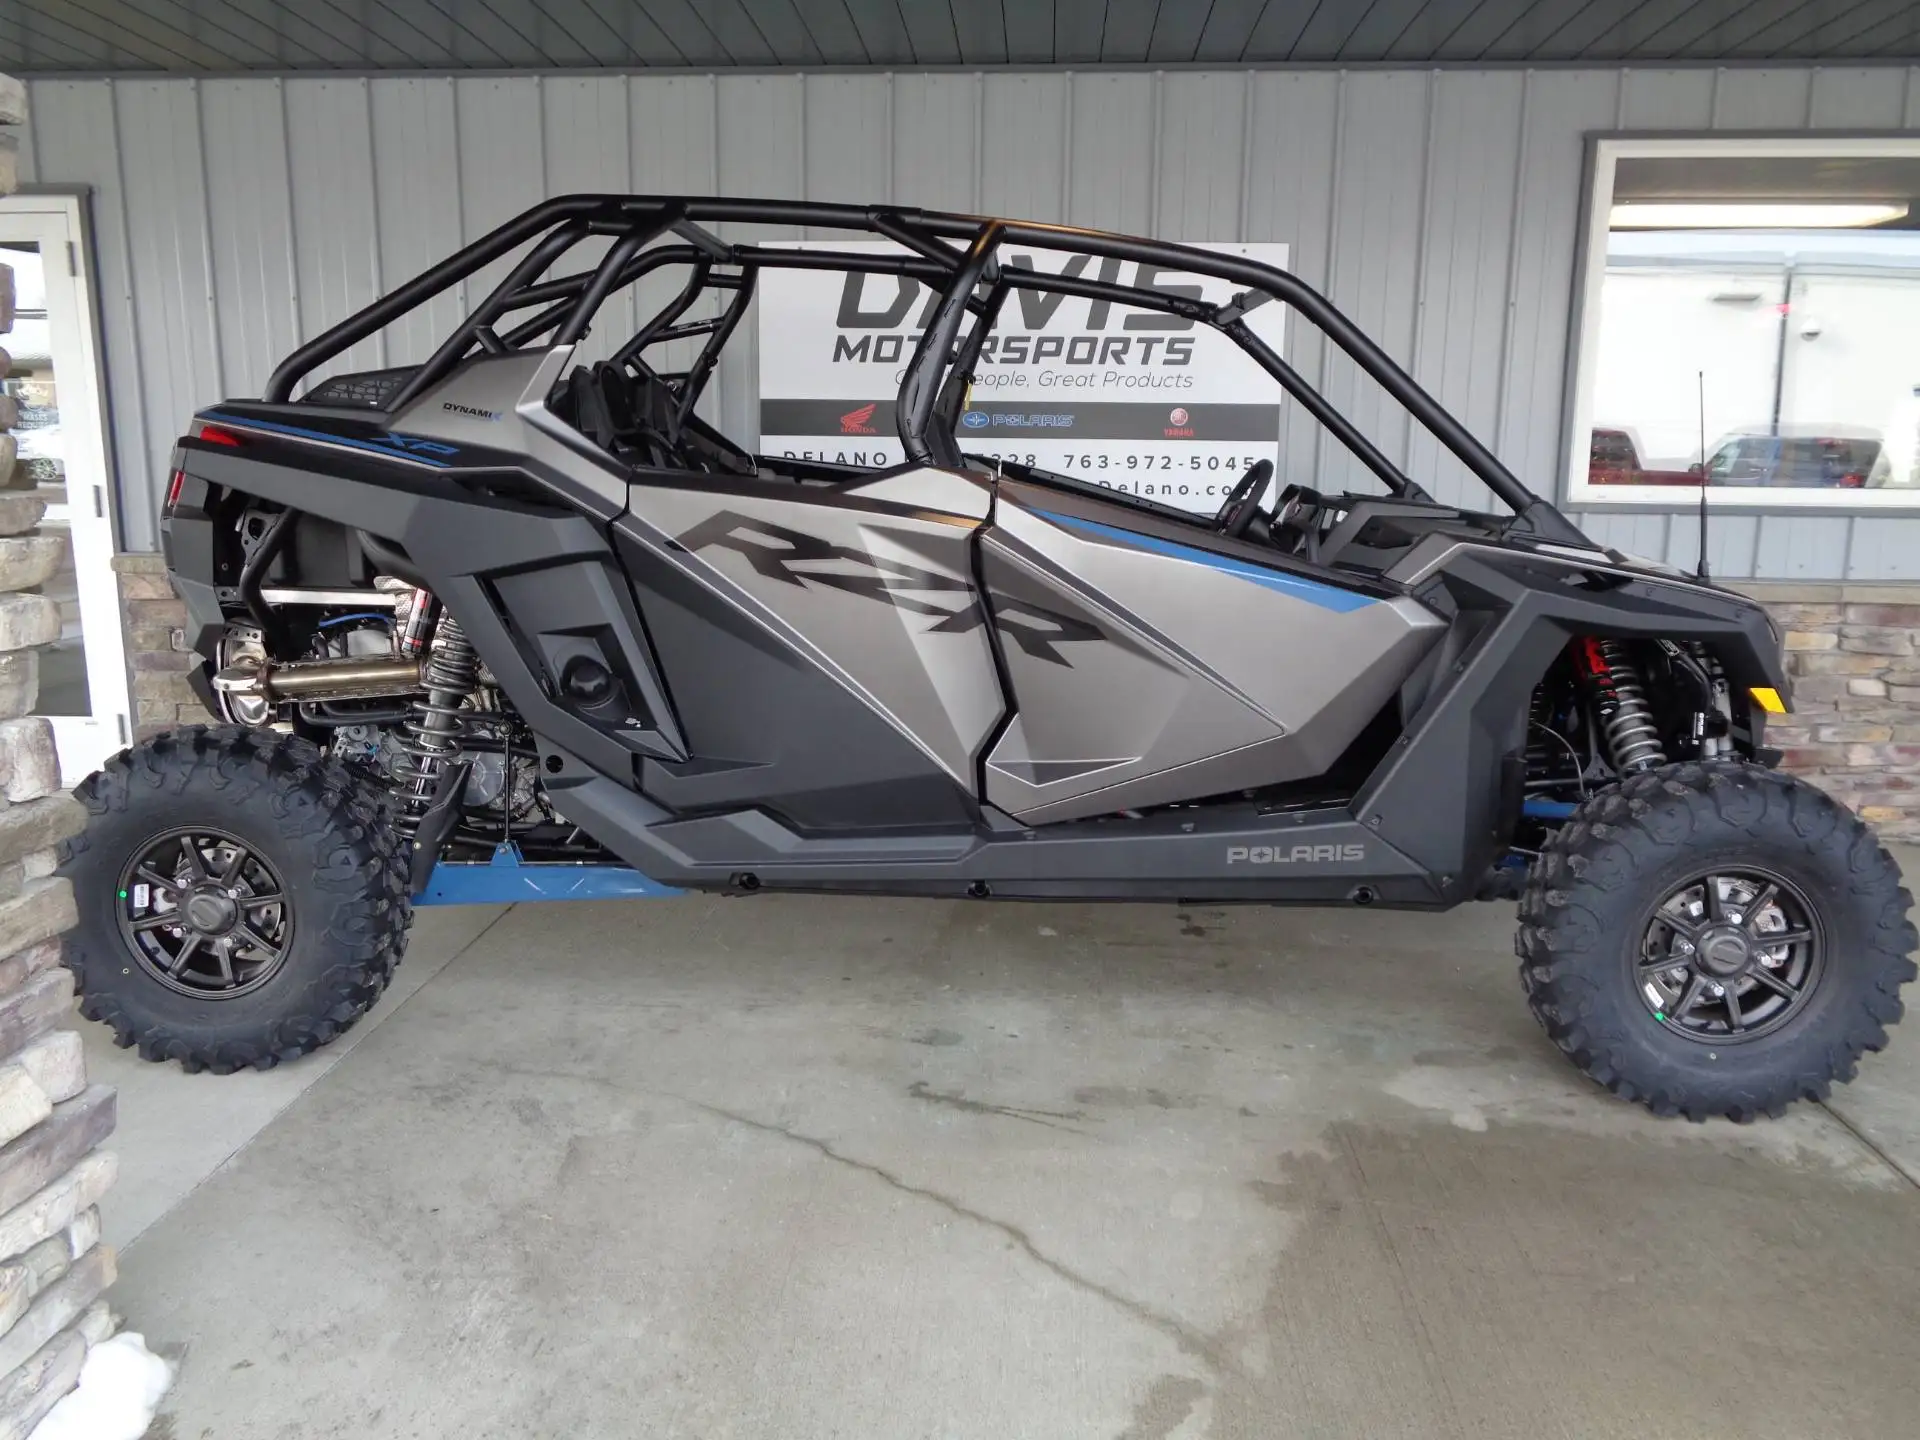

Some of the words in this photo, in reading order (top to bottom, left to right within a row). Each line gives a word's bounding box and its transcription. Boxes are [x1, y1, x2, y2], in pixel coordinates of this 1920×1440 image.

[836, 255, 1203, 331] DVIS
[972, 370, 1029, 390] eople,
[1038, 370, 1096, 388] Great
[1102, 371, 1194, 389] Products
[992, 414, 1074, 428] POLARIS
[1064, 454, 1254, 471] 763-972-5045
[1227, 844, 1364, 864] POLARIS
